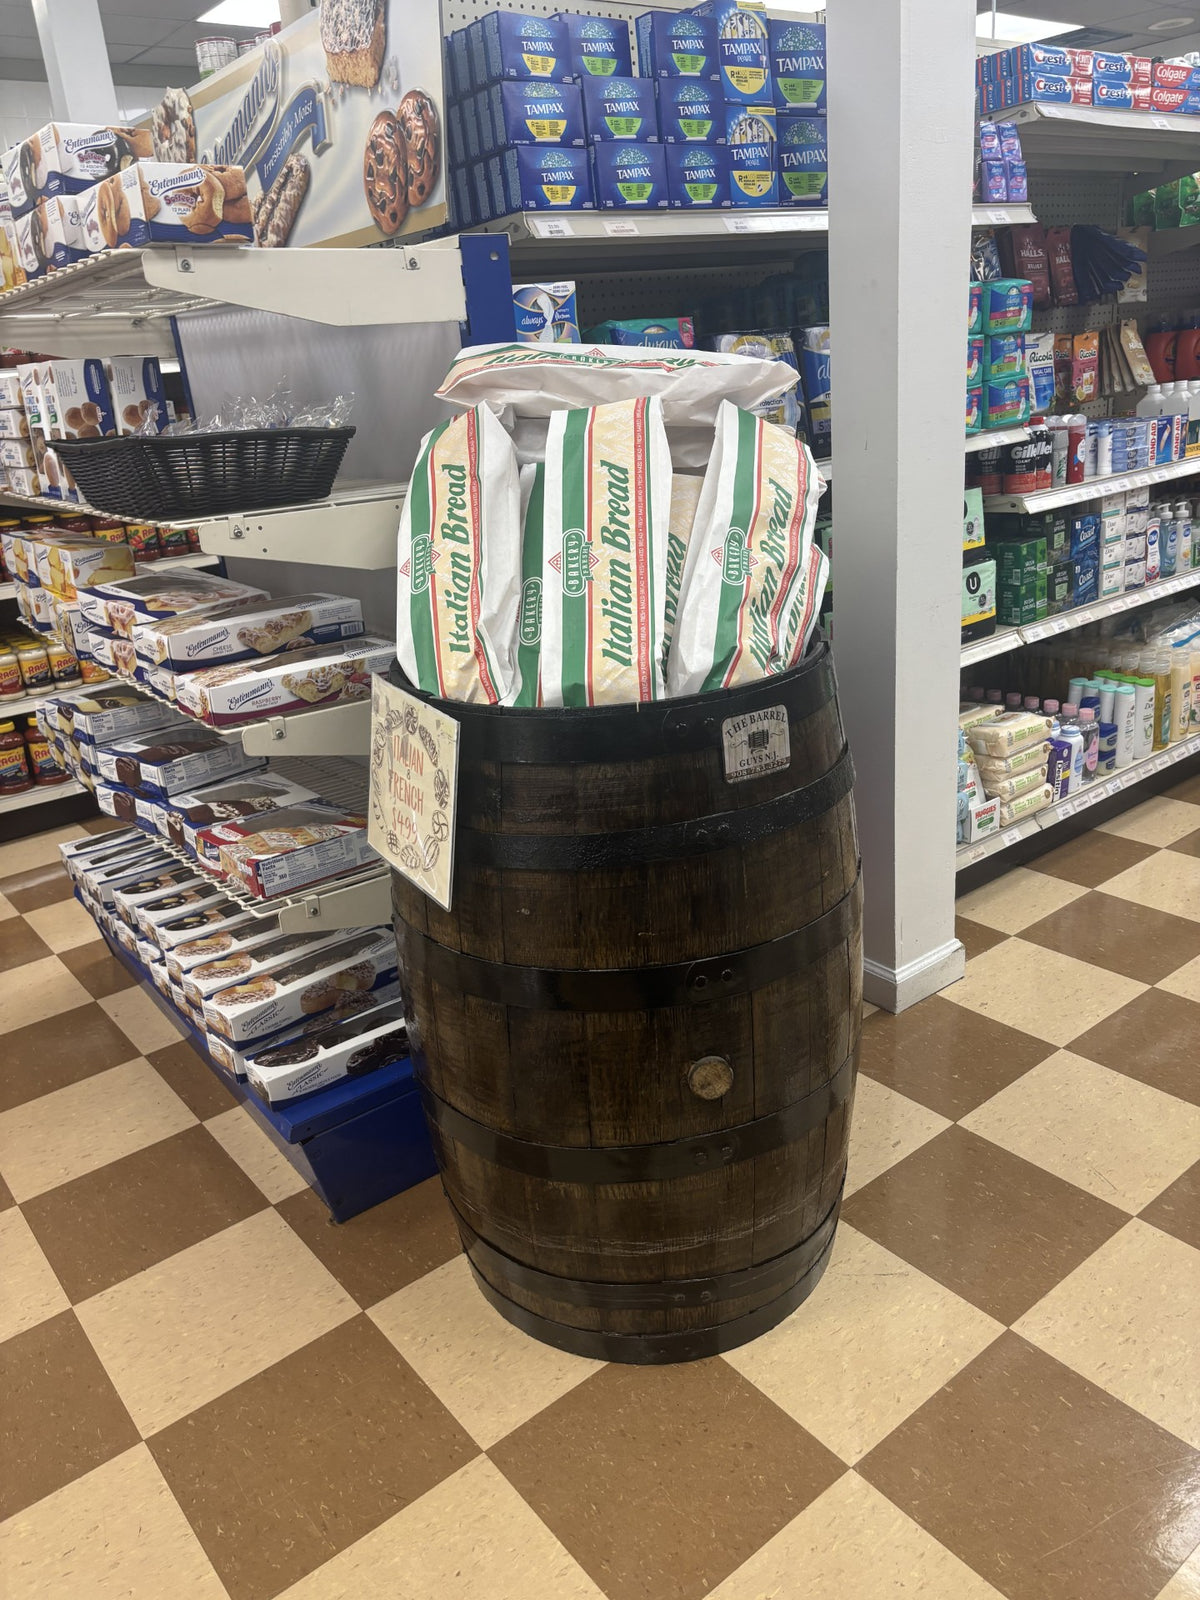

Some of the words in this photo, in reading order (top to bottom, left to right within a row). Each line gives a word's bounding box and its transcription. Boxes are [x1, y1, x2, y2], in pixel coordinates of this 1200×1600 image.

[522, 41, 554, 52] TAMPAX
[581, 42, 615, 53] TAMPAX
[671, 39, 705, 50] TAMPAX
[722, 42, 762, 55] TAMPAX
[776, 55, 824, 73] TAMPAX
[1034, 50, 1063, 65] Crest
[1097, 59, 1124, 73] Crest
[1156, 65, 1187, 80] Colgate
[1035, 79, 1064, 92] Crest
[1098, 86, 1126, 99] Crest
[1152, 90, 1185, 104] Colgate
[524, 102, 564, 115] TAMPAX
[604, 101, 640, 114] TAMPAX
[678, 104, 711, 116] TAMPAX
[64, 131, 116, 154] Entenmann's
[263, 123, 294, 179] Irresistibly
[293, 100, 314, 134] Moist
[731, 145, 769, 161] TAMPAX
[780, 148, 827, 167] TAMPAX
[541, 170, 574, 182] TAMPAX
[616, 166, 651, 180] TAMPAX
[684, 168, 716, 180] TAMPAX
[149, 168, 205, 197] Entenmann's
[1056, 256, 1071, 264] HALL
[521, 315, 544, 327] always
[1029, 351, 1053, 364] Ricola
[1079, 349, 1097, 360] Ricola
[760, 398, 783, 407] rotection
[440, 463, 470, 546] Bread
[600, 459, 631, 553] Bread
[760, 477, 793, 568] Bread
[1080, 526, 1095, 542] Coast
[414, 541, 425, 585] BAKERY
[568, 539, 578, 585] BAKERY
[729, 535, 742, 577] BAKERY
[743, 549, 751, 573] FRESH
[969, 576, 978, 591] U
[1079, 569, 1094, 585] Coast
[441, 552, 471, 654] Italian
[524, 586, 538, 634] BAKERY
[601, 558, 632, 667] Italian
[749, 566, 778, 670] Italian
[185, 626, 230, 658] Entenmann's
[212, 644, 233, 652] CHEESE
[227, 678, 275, 712] Entenmann's
[251, 695, 282, 707] RASPBERRY
[725, 718, 749, 739] THE
[749, 710, 787, 724] BARREL
[1027, 726, 1034, 736] 72
[393, 734, 424, 777] ITALIAN
[739, 754, 763, 768] GUYS
[765, 750, 779, 761] N.J.
[1054, 761, 1064, 795] Desitin
[389, 768, 424, 816] FRENCH
[975, 805, 996, 819] HUGGIES
[261, 857, 284, 867] Nutrition
[248, 1006, 285, 1037] CLASSIC
[292, 1068, 329, 1096] CLASSIC
